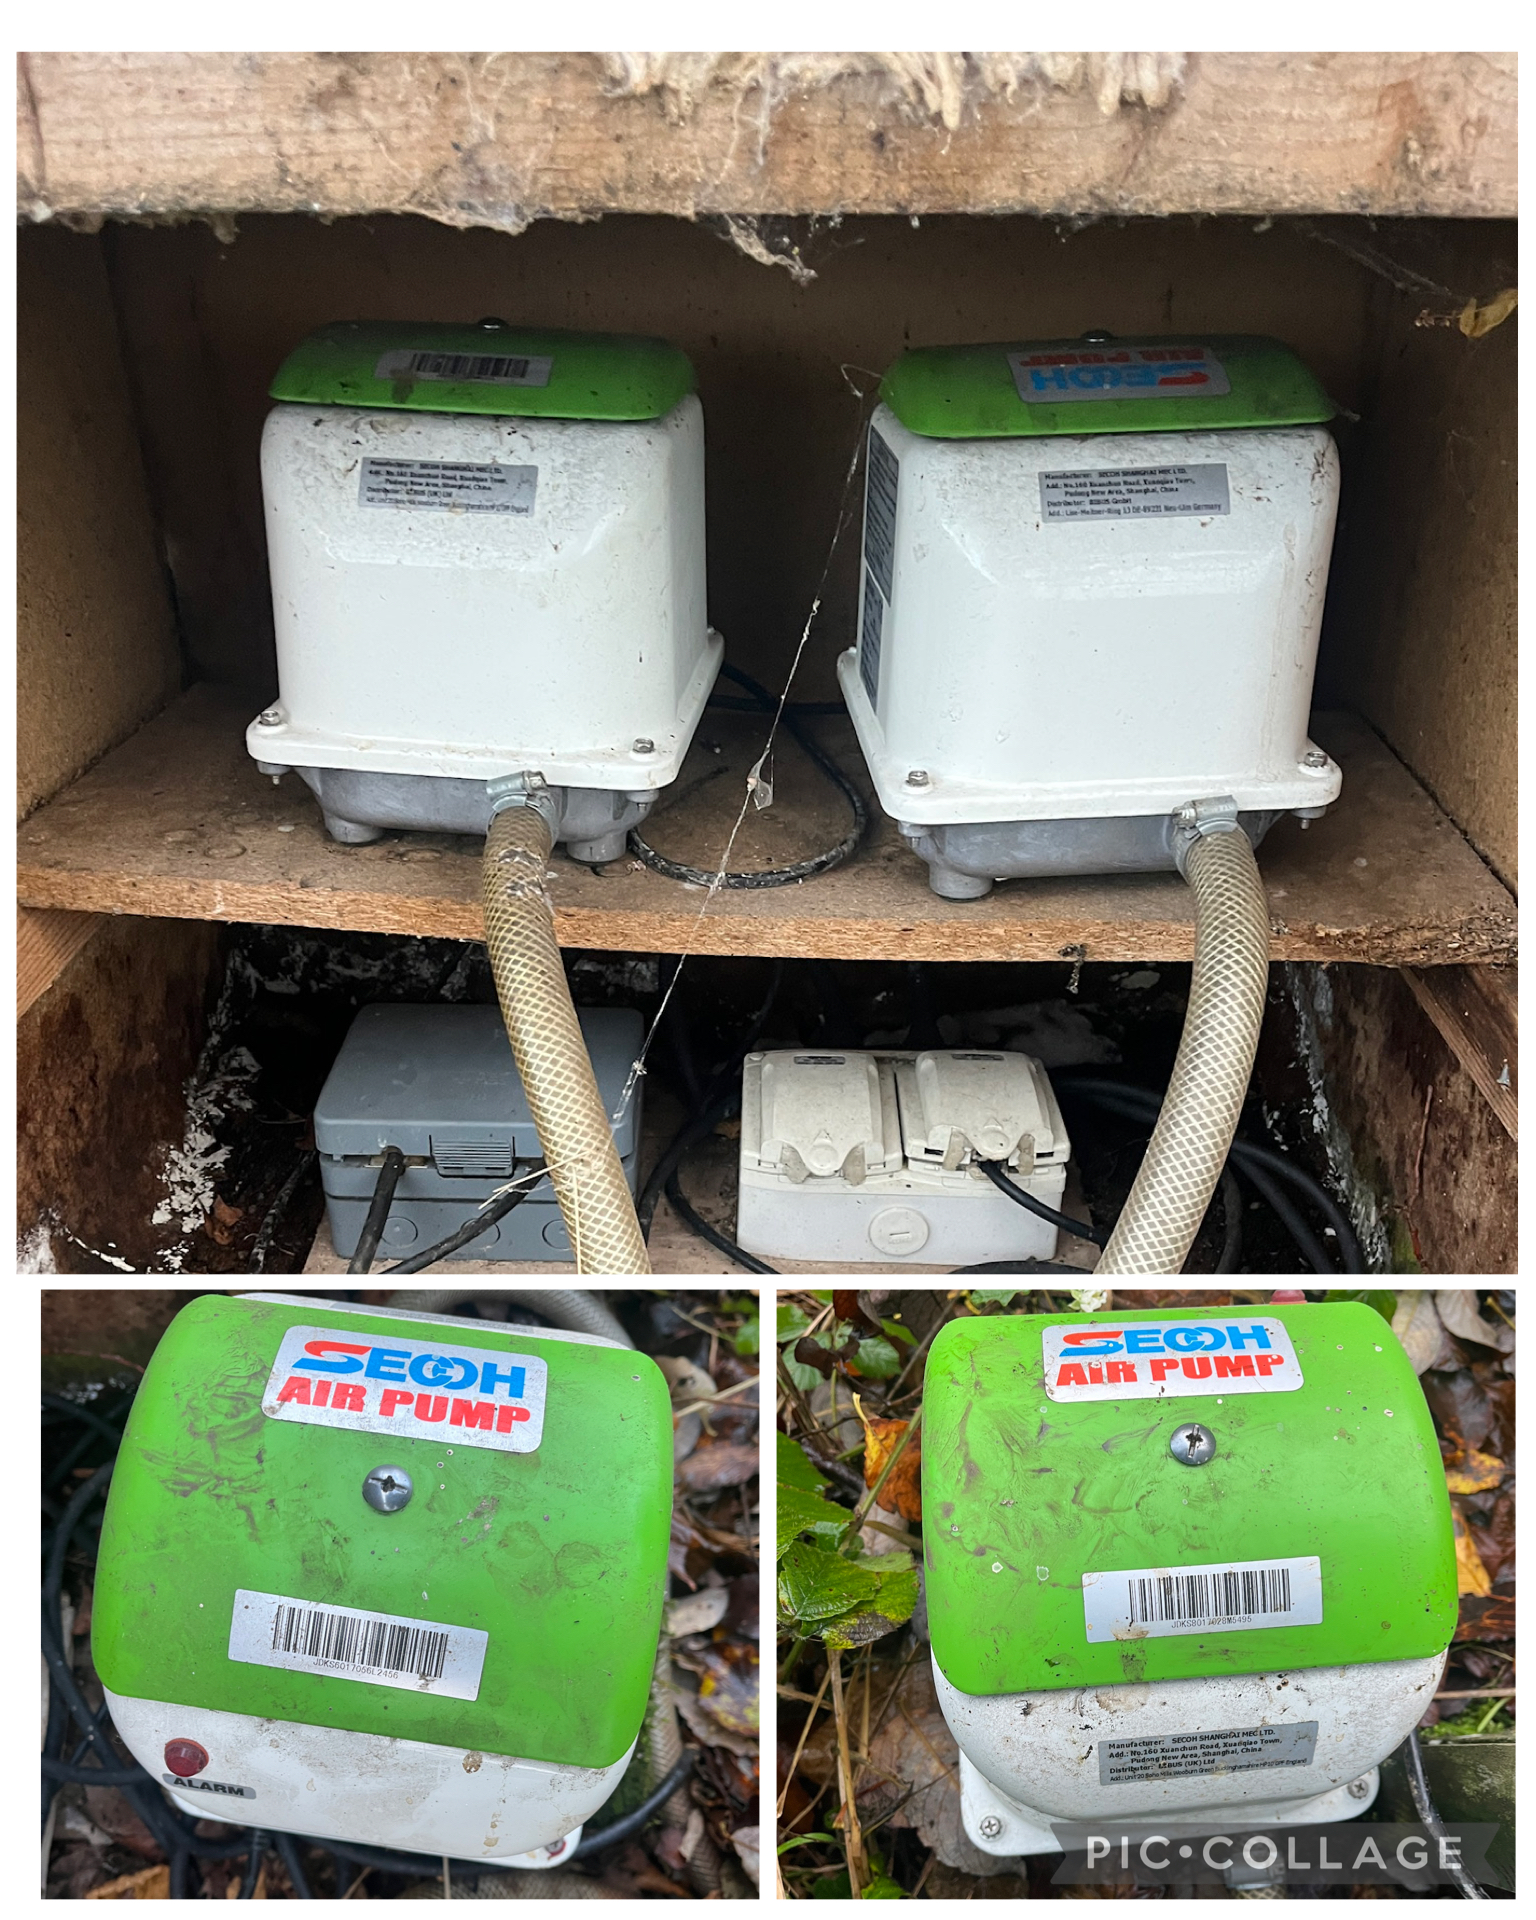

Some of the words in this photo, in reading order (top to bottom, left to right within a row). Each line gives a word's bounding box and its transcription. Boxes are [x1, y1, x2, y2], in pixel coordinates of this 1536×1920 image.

[1059, 1325, 1272, 1357] SECOH
[292, 1340, 526, 1399] SECOH
[1056, 1361, 1137, 1386] AIR
[1149, 1354, 1284, 1381] PUMP
[276, 1375, 367, 1412] AIR
[379, 1388, 531, 1434] PUMP
[1108, 1740, 1164, 1750] Manufacturer:
[1172, 1736, 1198, 1744] SECOH
[1199, 1732, 1240, 1740] SHANGHAI
[1242, 1730, 1258, 1738] MEC
[1160, 1745, 1198, 1753] Xuanchun
[1223, 1740, 1258, 1748] Xuanqiao
[1130, 1756, 1160, 1764] Pudong
[1180, 1752, 1200, 1760] Area,
[1202, 1749, 1239, 1757] Shanghai,
[1110, 1764, 1154, 1774] Distributor:
[1184, 1760, 1202, 1768] (UK)
[173, 1777, 244, 1796] ALARM
